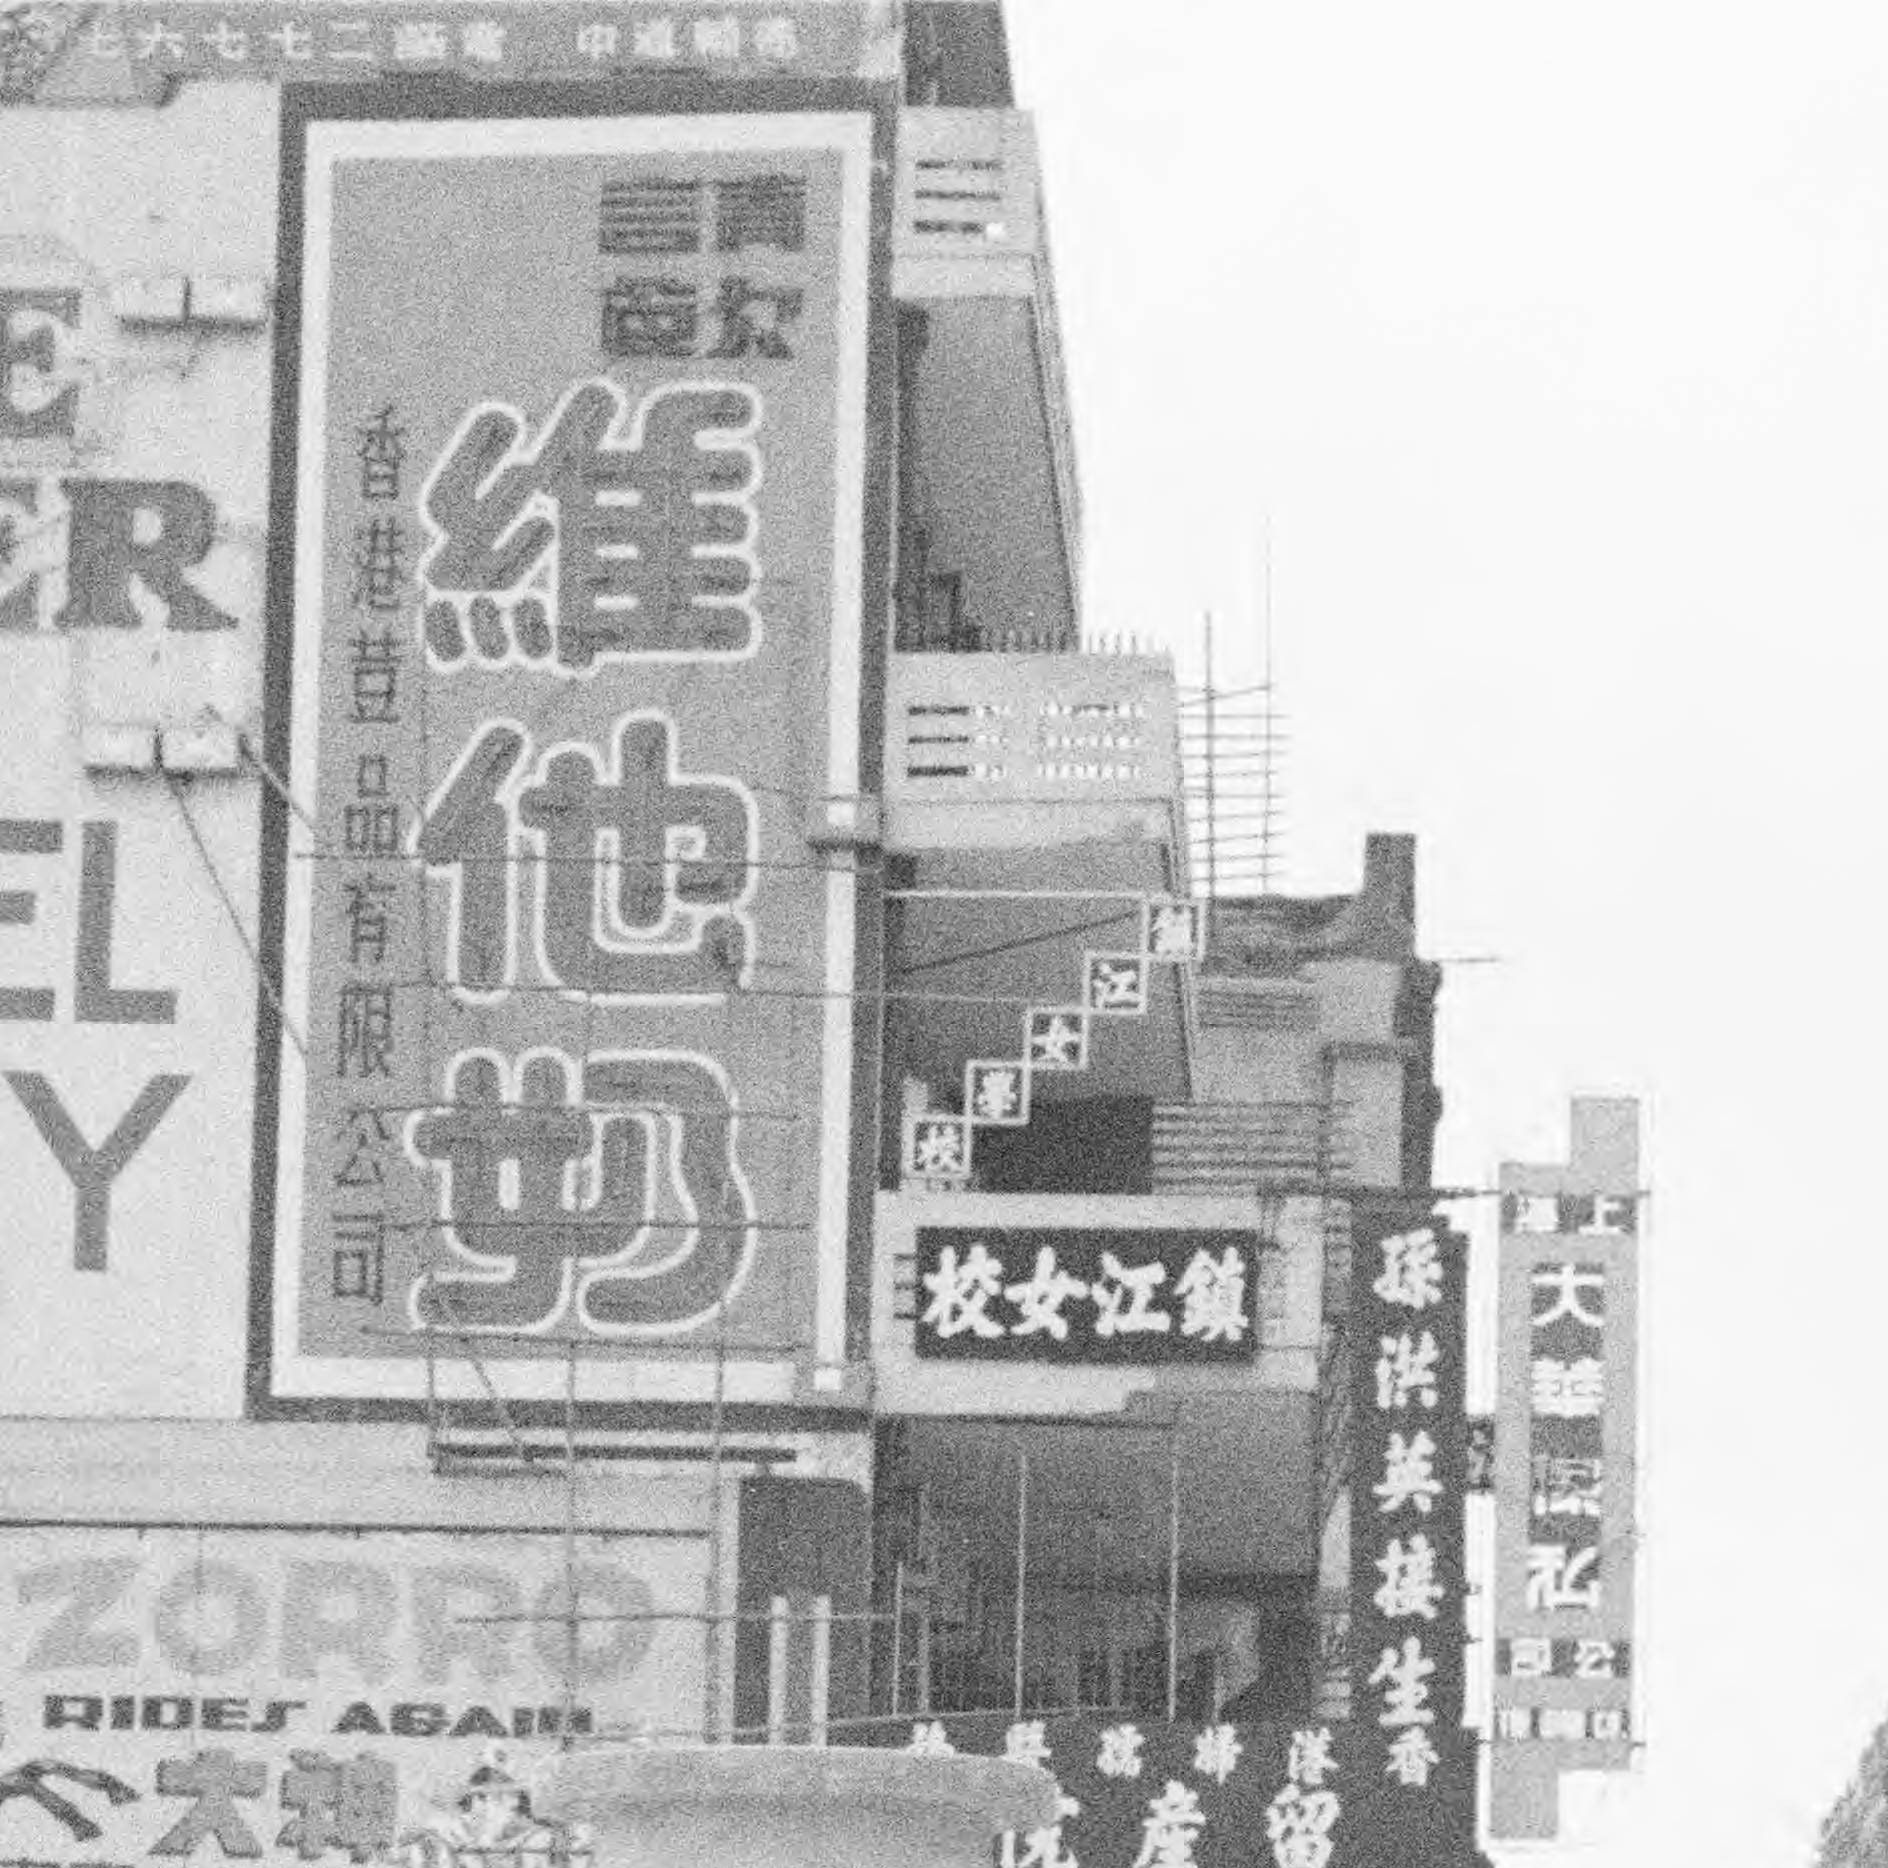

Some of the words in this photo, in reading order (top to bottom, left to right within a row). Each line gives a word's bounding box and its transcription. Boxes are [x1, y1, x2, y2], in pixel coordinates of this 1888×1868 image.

[404, 377, 767, 1335] 維他奶
[921, 1245, 1251, 1342] 鎮江女校
[14, 1554, 660, 1683] ZORRO
[42, 1692, 307, 1737] RIDES
[333, 1701, 595, 1741] AGAIN
